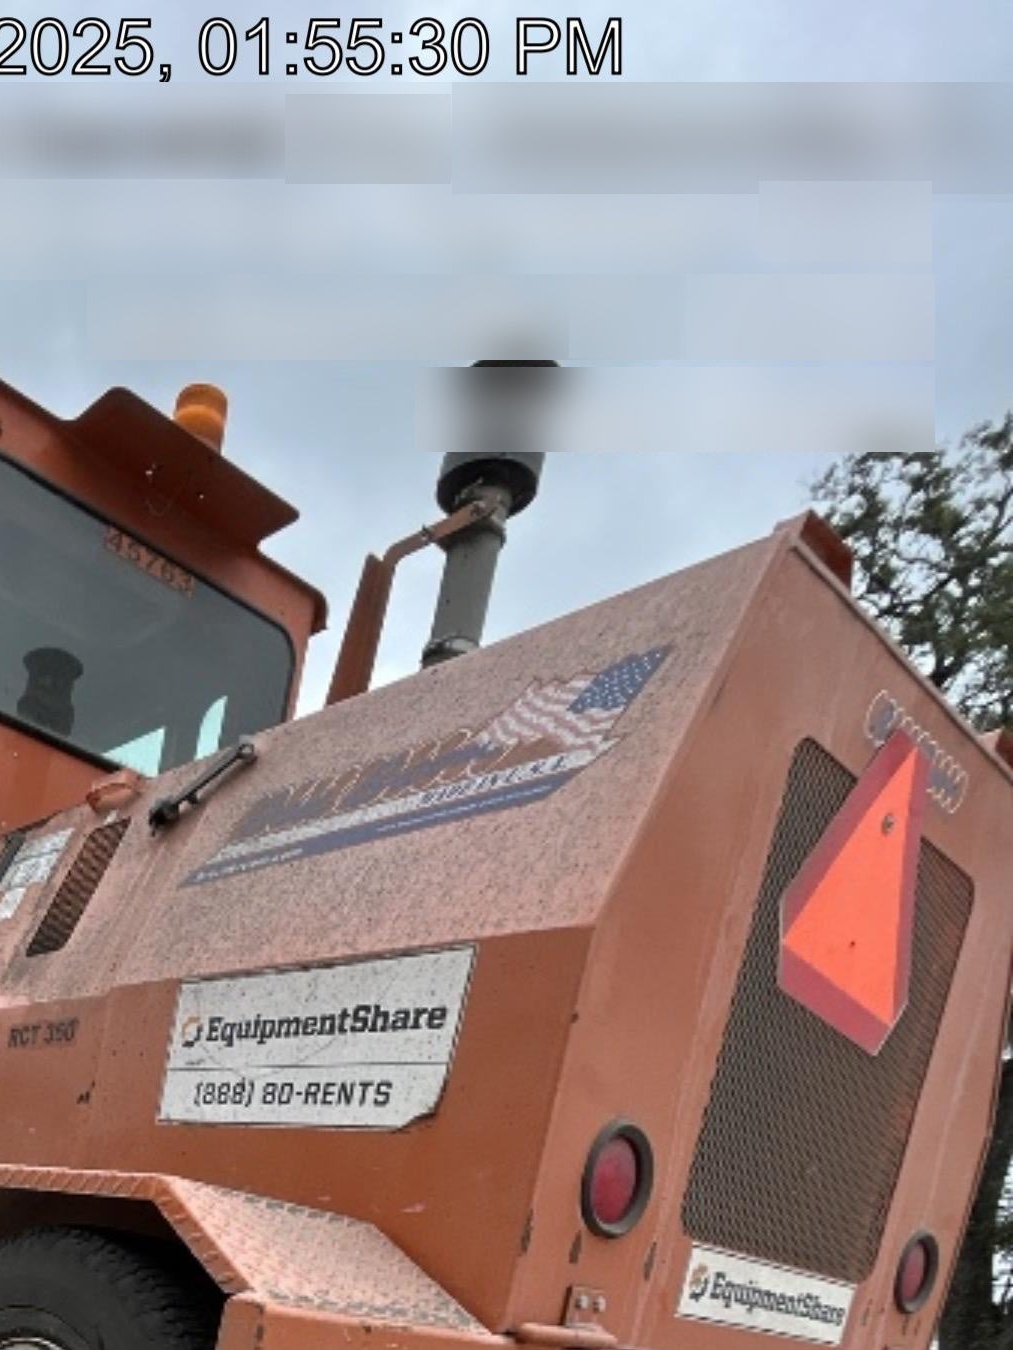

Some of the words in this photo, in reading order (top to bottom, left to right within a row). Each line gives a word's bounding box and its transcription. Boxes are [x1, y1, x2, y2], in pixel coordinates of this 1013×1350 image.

[205, 1003, 448, 1047] EquipmentShare
[194, 1080, 254, 1108] (888)
[262, 1079, 393, 1107] 80-RENTS
[709, 1271, 846, 1326] EquipmentShare
